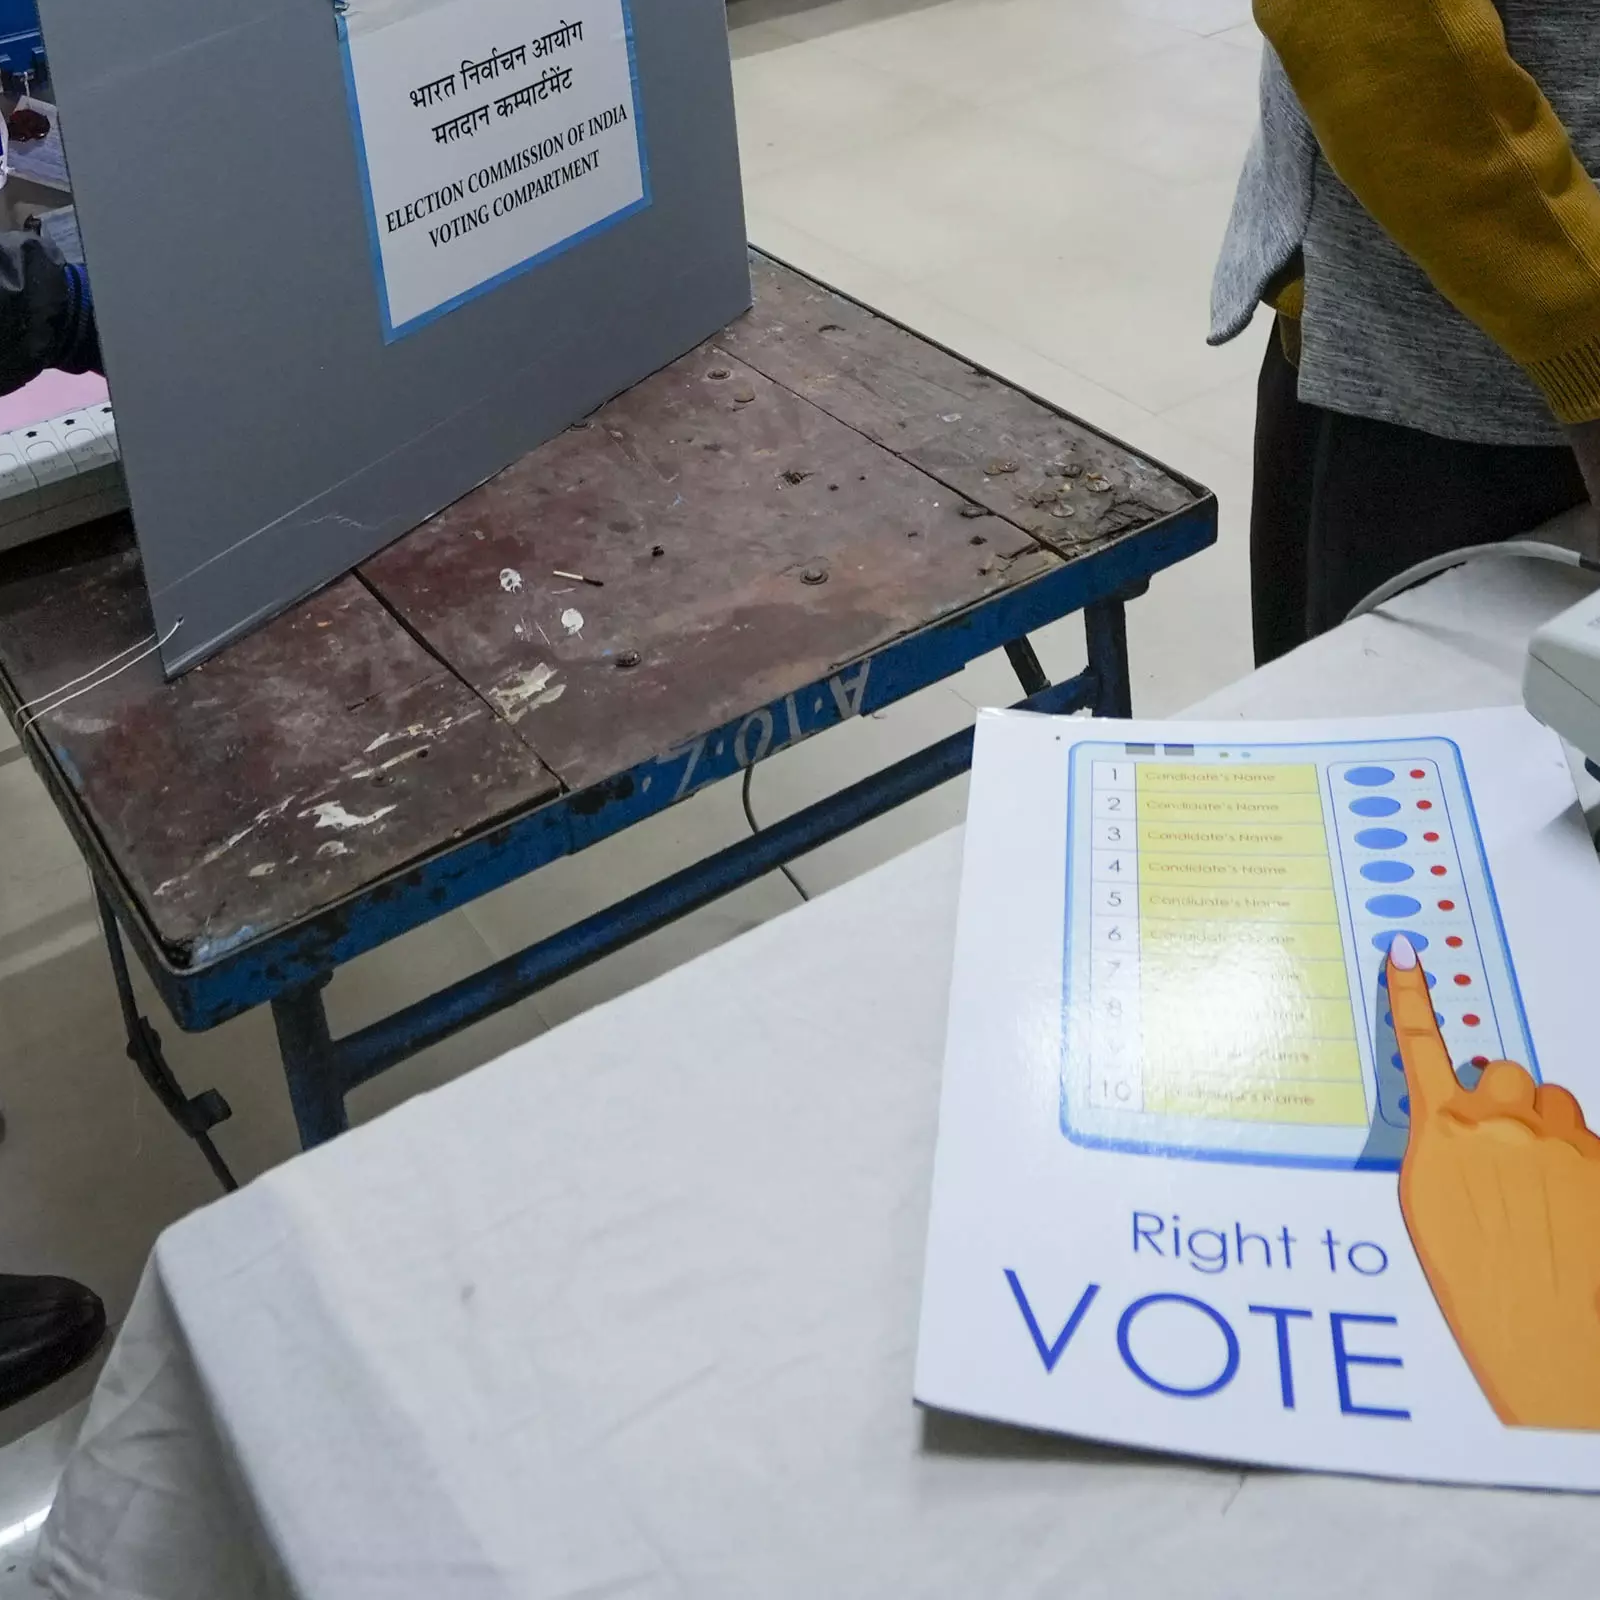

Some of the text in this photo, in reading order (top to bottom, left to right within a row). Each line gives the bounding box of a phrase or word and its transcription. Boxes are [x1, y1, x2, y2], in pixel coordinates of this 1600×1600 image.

[409, 19, 584, 109] भारत निर्वाचन आयोग
[431, 104, 491, 145] मतदान
[385, 103, 629, 234] ELECTION COMMISSION OF INDIA
[428, 148, 601, 249] VOTING COMPARTMENT
[1111, 767, 1277, 783] 1 Candidate's Name
[1106, 797, 1280, 813] 2 Candidate's Name
[1106, 826, 1284, 843] 3 Candidate's Name
[1107, 858, 1288, 875] 4 Candidate's Name
[1106, 891, 1291, 908] 5 Candidate's Name
[1107, 925, 1123, 942] 6
[1102, 1080, 1132, 1102] 10
[1132, 1210, 1389, 1277] Right to
[1003, 1267, 1413, 1422] VOTE
